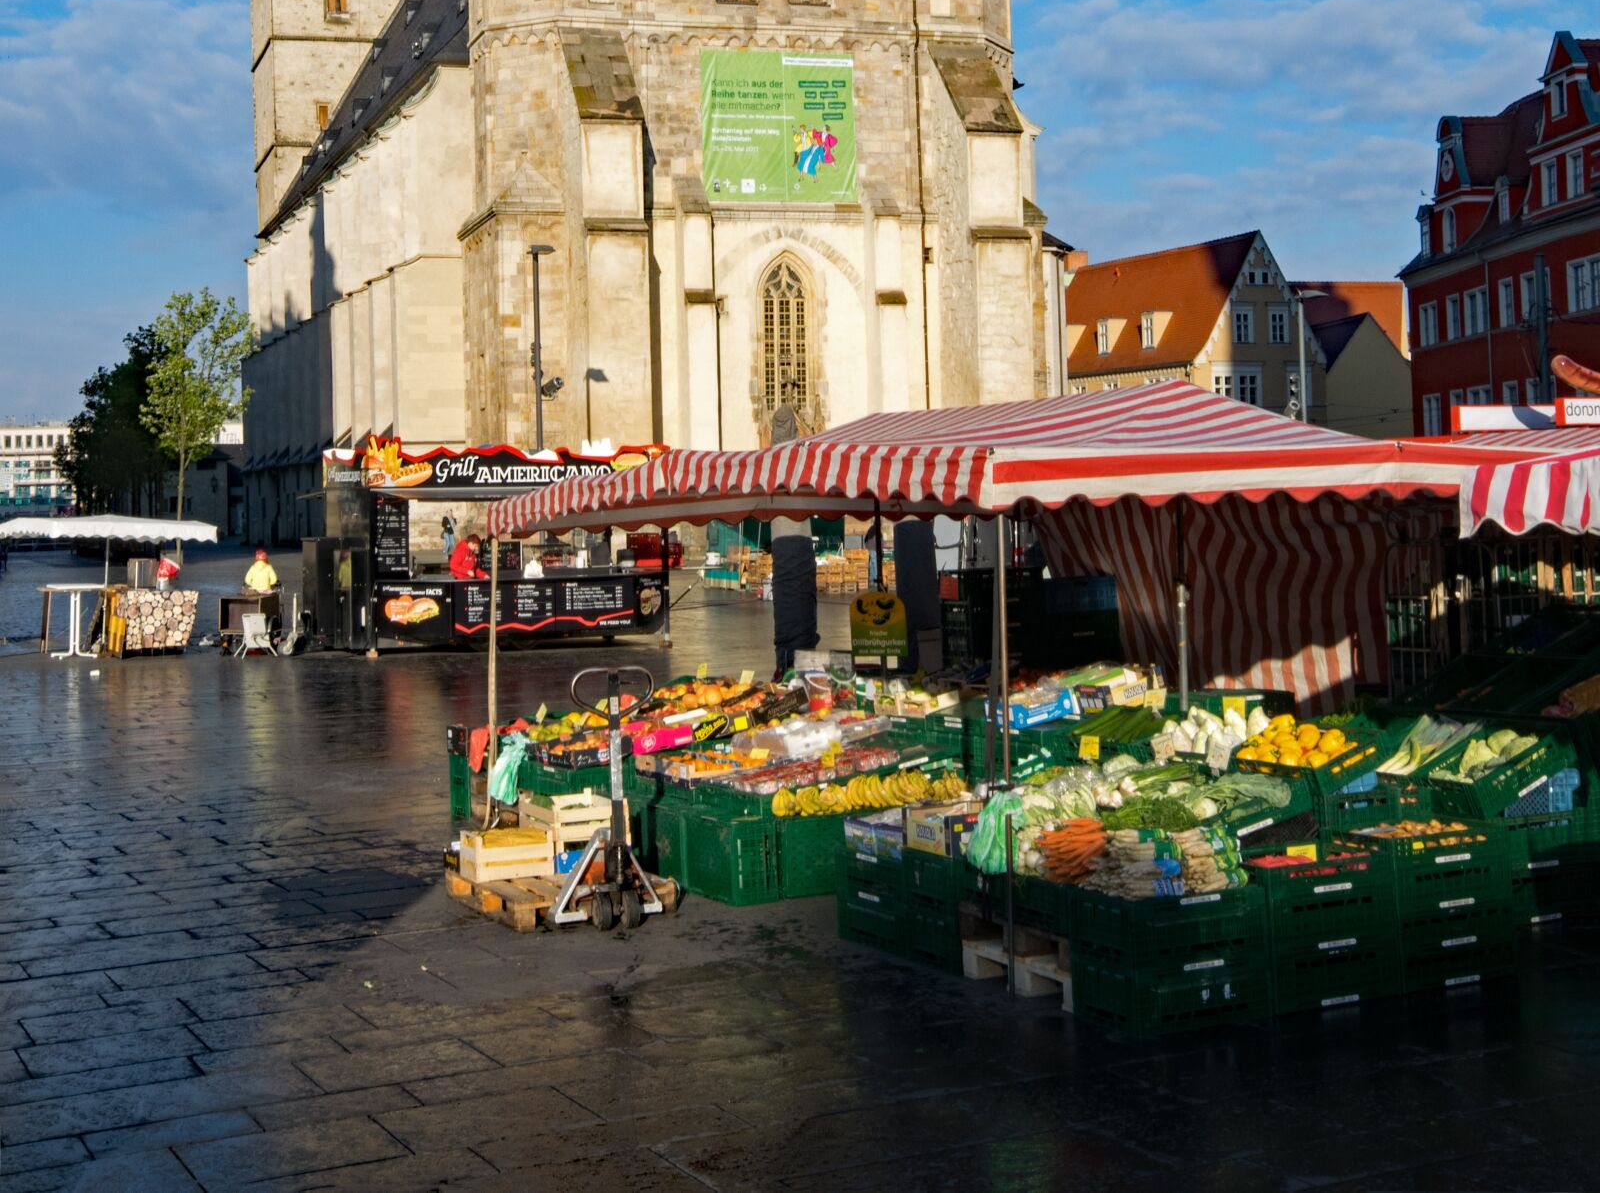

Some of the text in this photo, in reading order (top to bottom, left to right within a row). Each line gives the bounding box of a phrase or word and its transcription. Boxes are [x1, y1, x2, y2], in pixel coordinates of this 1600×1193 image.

[736, 79, 749, 88] ich
[769, 79, 784, 88] der
[711, 90, 736, 99] Reihe
[772, 92, 795, 100] wenn
[728, 102, 781, 111] mitmachen?
[435, 455, 612, 484] Grill AMERICANO
